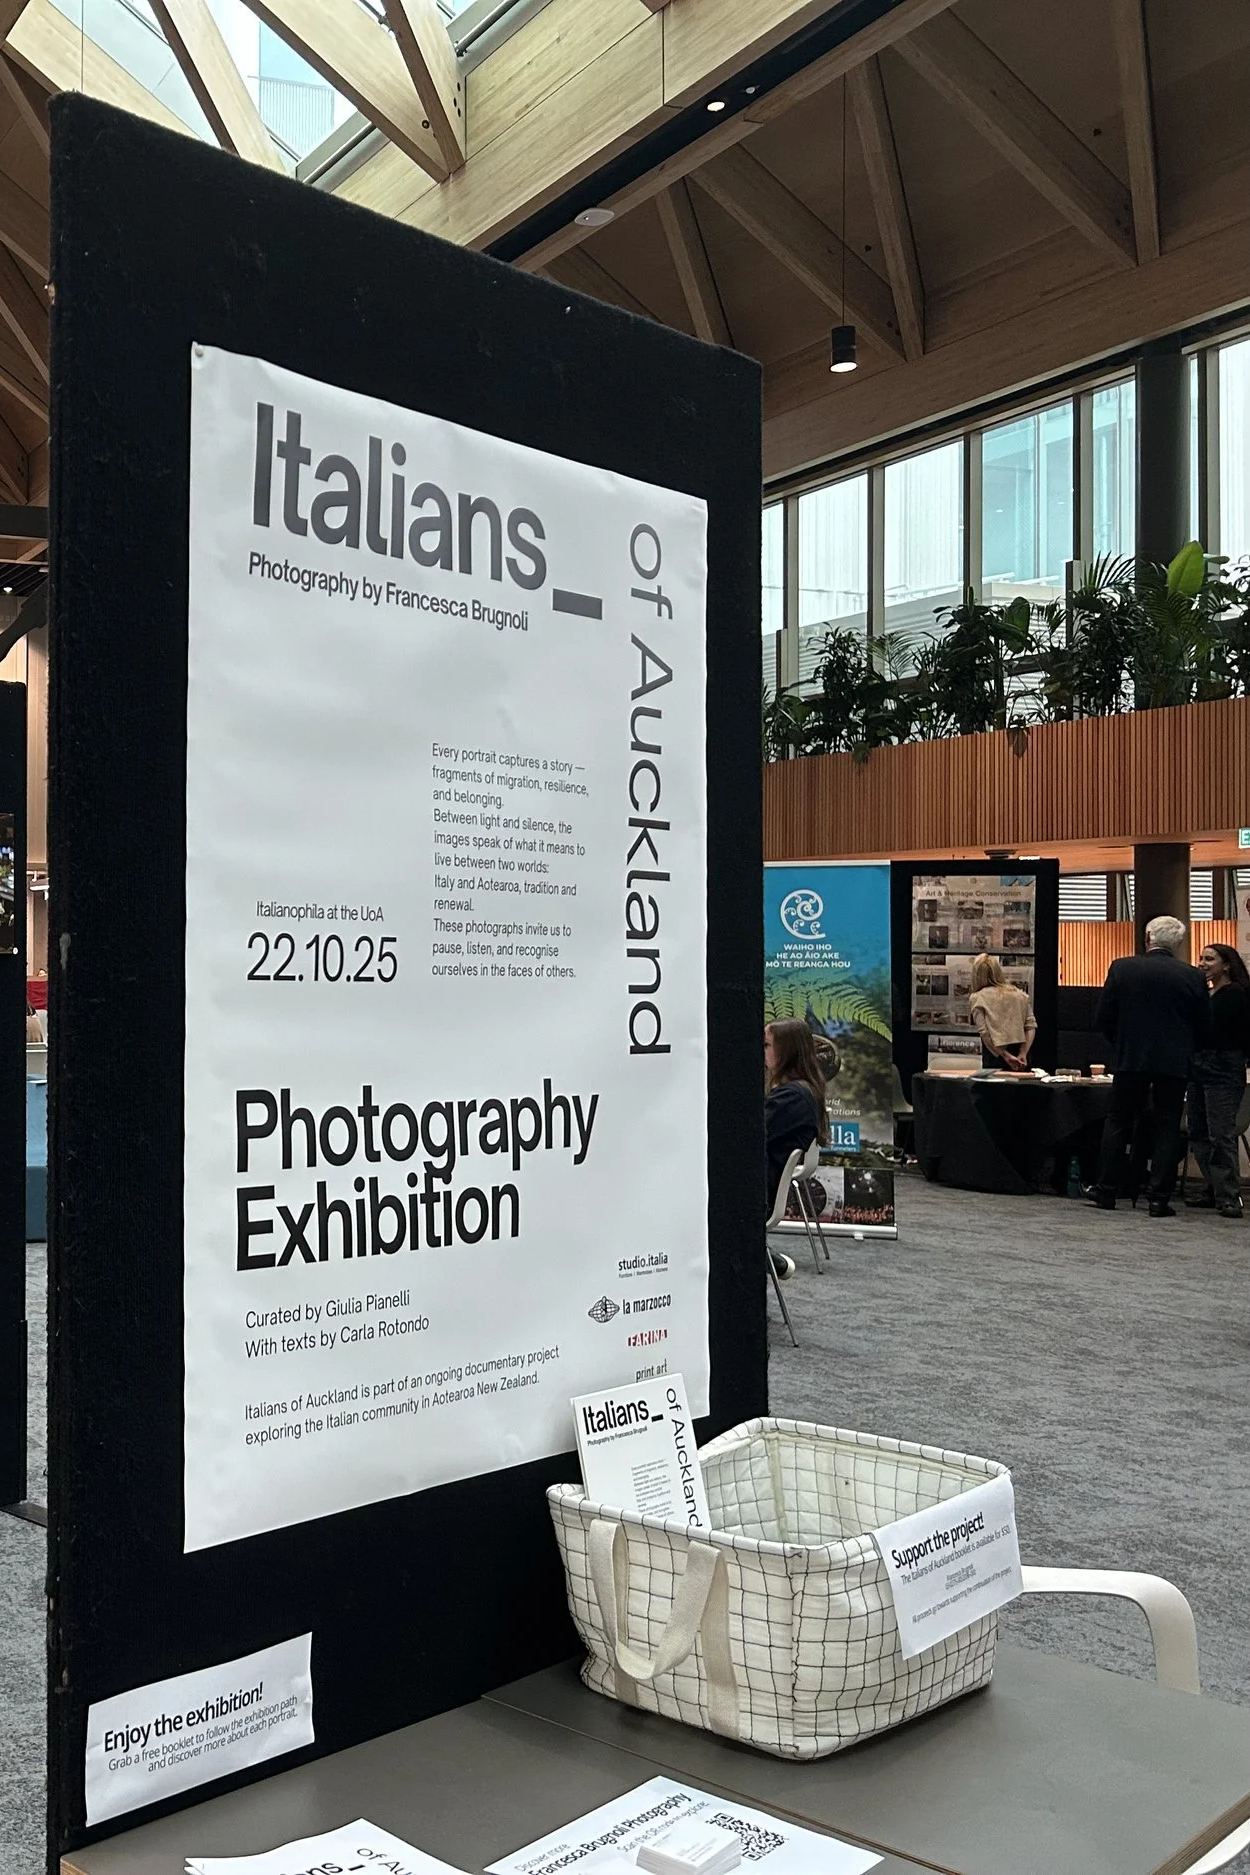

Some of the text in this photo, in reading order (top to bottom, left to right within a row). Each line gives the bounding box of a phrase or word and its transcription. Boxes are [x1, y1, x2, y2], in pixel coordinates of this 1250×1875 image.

[249, 551, 528, 631] Photography by Francesca Brugnoli
[432, 743, 573, 775] Every portrait captures a story
[432, 765, 589, 797] fragments of migration, resilience,
[626, 523, 673, 1056] of Auckland
[433, 788, 504, 809] and belonging.
[434, 808, 572, 835] Between light and silence, the
[434, 830, 586, 856] images speak of what it means to
[434, 852, 549, 874] live between two worlds:
[434, 874, 577, 896] Italy and Aotearoa, tradition and
[256, 901, 384, 921] Italianophila at the UoA
[433, 898, 474, 911] renewal.
[433, 918, 572, 937] These photographs invite us to
[247, 932, 398, 983] 22.10.25
[432, 941, 559, 959] pause, listen, and recognise
[432, 962, 576, 978] ourselves in the faces of others.
[236, 1077, 600, 1177] Photography
[830, 1125, 856, 1146] lla
[236, 1172, 520, 1271] Exhibition
[618, 1252, 668, 1271] studio.italia
[246, 1289, 410, 1328] Curated by Giulia Pianelli
[623, 1294, 671, 1314] la marzocco
[245, 1315, 430, 1358] With texts by Carla Rotondo
[245, 1345, 559, 1420] Italians of Auckland is part of an ongoing documentary project
[636, 1358, 667, 1383] print art
[246, 1371, 539, 1446] exploring the Italian community in Aotearoa New Zealand.
[666, 1388, 703, 1528] of Auckland
[891, 1511, 985, 1569] Support the project!
[105, 1681, 263, 1753] Enjoy the exhibition!
[108, 1694, 298, 1771] Grab a free booklet to follow the exhibition path
[148, 1707, 298, 1772] and discover more about each portrait.
[580, 1824, 630, 1851] Brugnoli
[622, 1792, 692, 1830] Photography
